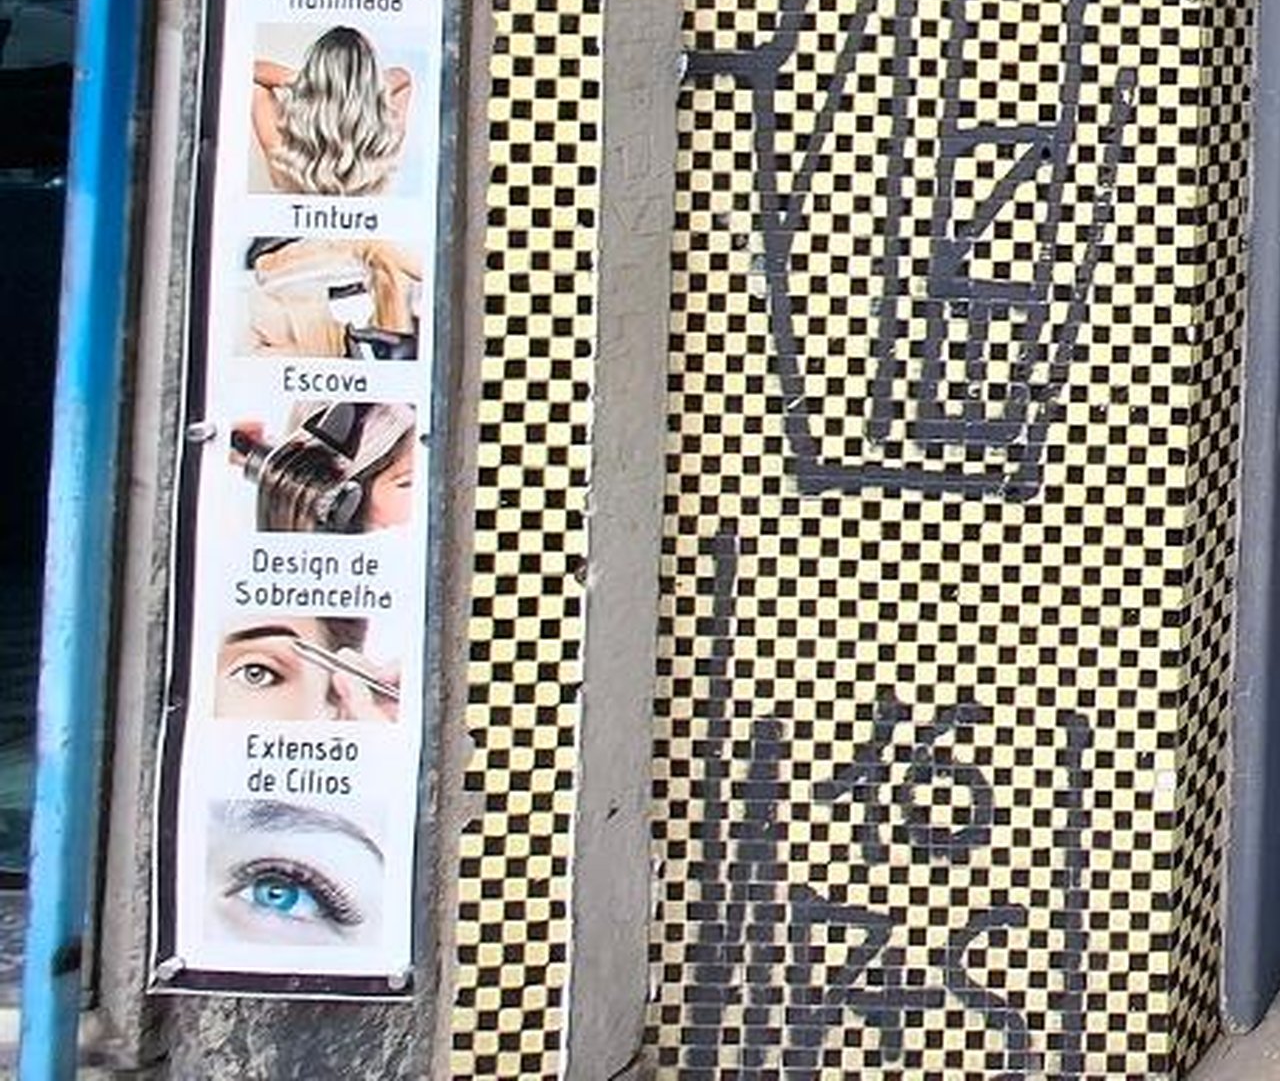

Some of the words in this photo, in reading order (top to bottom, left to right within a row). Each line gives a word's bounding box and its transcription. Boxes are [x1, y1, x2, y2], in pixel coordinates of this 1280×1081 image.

[292, 204, 379, 231] Tintura
[283, 367, 368, 392] Escova
[252, 548, 339, 580] Design
[351, 553, 379, 576] de
[235, 581, 393, 609] Sobrancelha
[247, 734, 359, 761] Extensão
[247, 770, 277, 792] de
